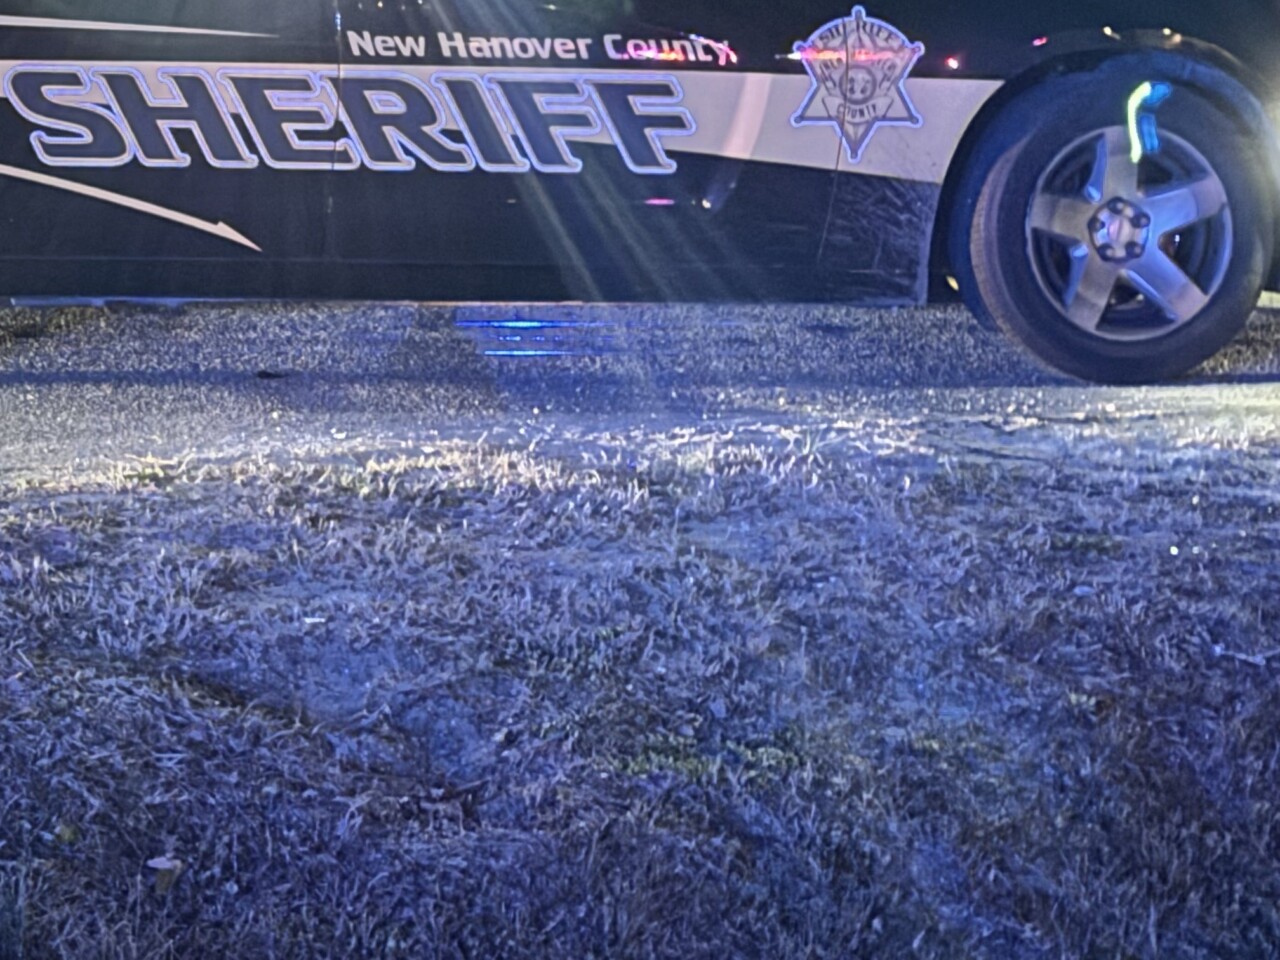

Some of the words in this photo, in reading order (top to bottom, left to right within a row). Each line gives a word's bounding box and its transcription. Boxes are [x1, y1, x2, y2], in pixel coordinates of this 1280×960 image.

[346, 30, 426, 58] New
[438, 32, 592, 60] Hanover
[604, 34, 737, 65] County
[3, 62, 696, 174] SHERIFF
